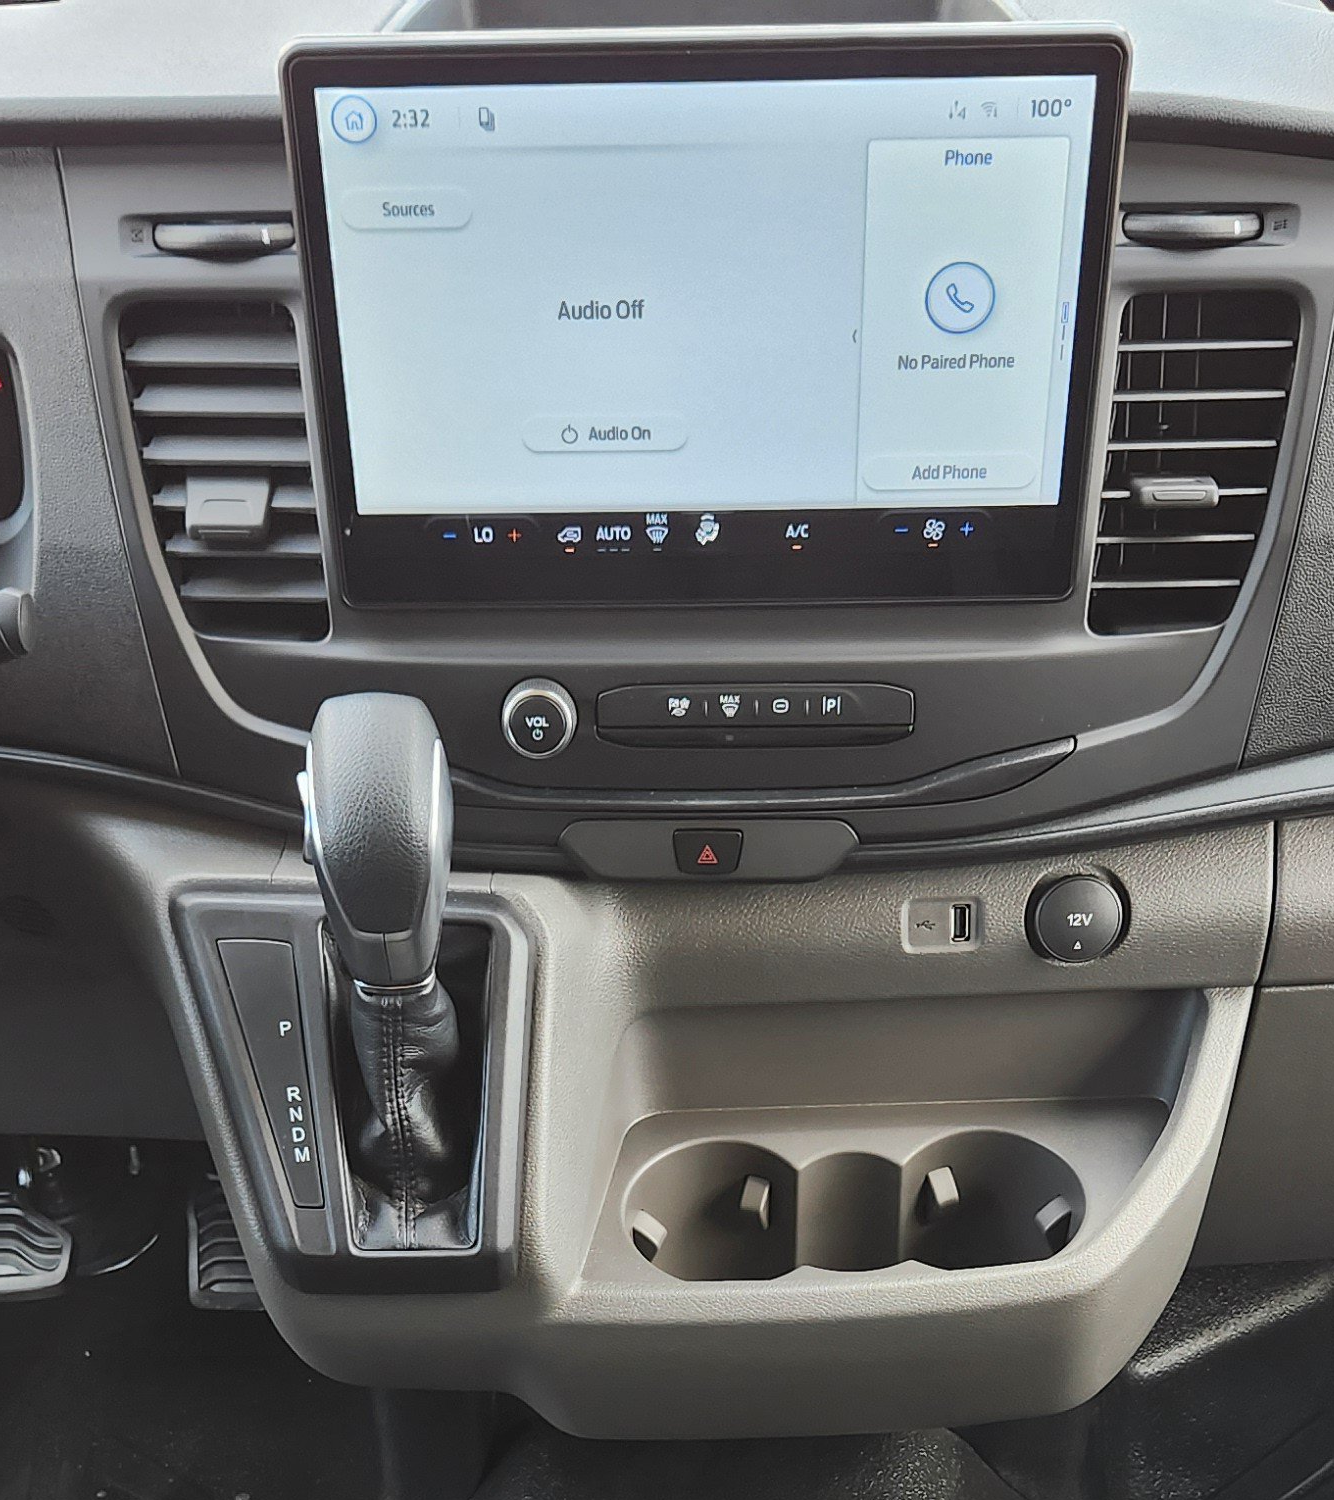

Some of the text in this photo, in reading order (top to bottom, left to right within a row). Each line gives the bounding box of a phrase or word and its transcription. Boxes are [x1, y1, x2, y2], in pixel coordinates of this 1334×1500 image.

[1030, 98, 1072, 118] 100°
[391, 109, 430, 128] 2:32
[944, 149, 993, 166] Phone
[382, 202, 435, 217] Sources
[557, 299, 645, 320] Audio Off
[897, 354, 1015, 370] No Paired Phone
[588, 426, 651, 441] Audio On
[911, 465, 987, 480] Add Phone
[645, 513, 668, 525] MAX
[474, 526, 495, 543] LO
[595, 525, 632, 541] AUTO
[785, 523, 809, 539] A/C
[720, 694, 741, 704] MAX
[525, 716, 549, 729] VOL
[1067, 913, 1093, 927] 12V
[279, 1021, 292, 1036] P
[287, 1086, 302, 1102] R
[289, 1107, 303, 1122] N
[292, 1127, 306, 1142] D
[294, 1147, 310, 1162] M
